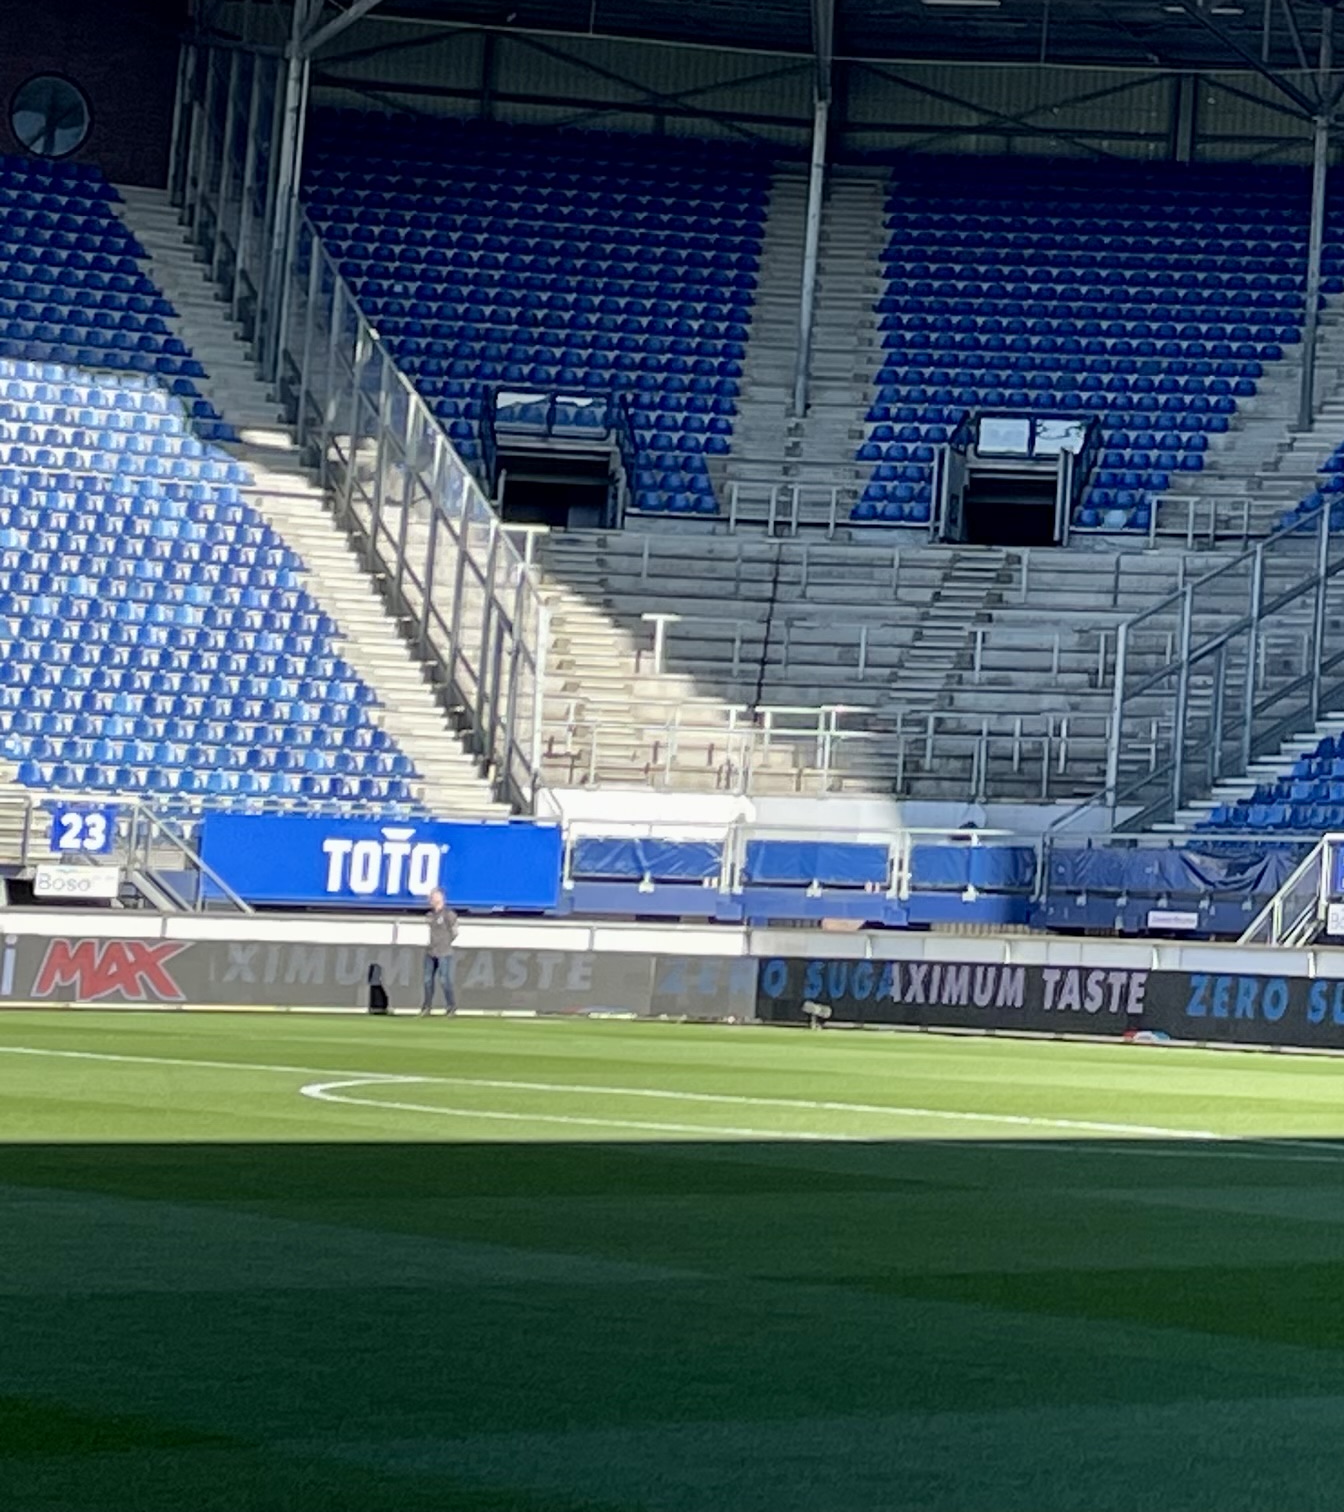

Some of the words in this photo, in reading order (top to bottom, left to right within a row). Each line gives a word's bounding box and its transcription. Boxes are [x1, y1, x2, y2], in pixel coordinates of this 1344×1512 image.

[59, 813, 107, 850] 23
[322, 838, 442, 896] TOTO
[31, 938, 195, 1002] MAX
[210, 943, 411, 987] XIMUM
[1042, 968, 1147, 1014] TASTE
[1186, 974, 1289, 1022] ZERO
